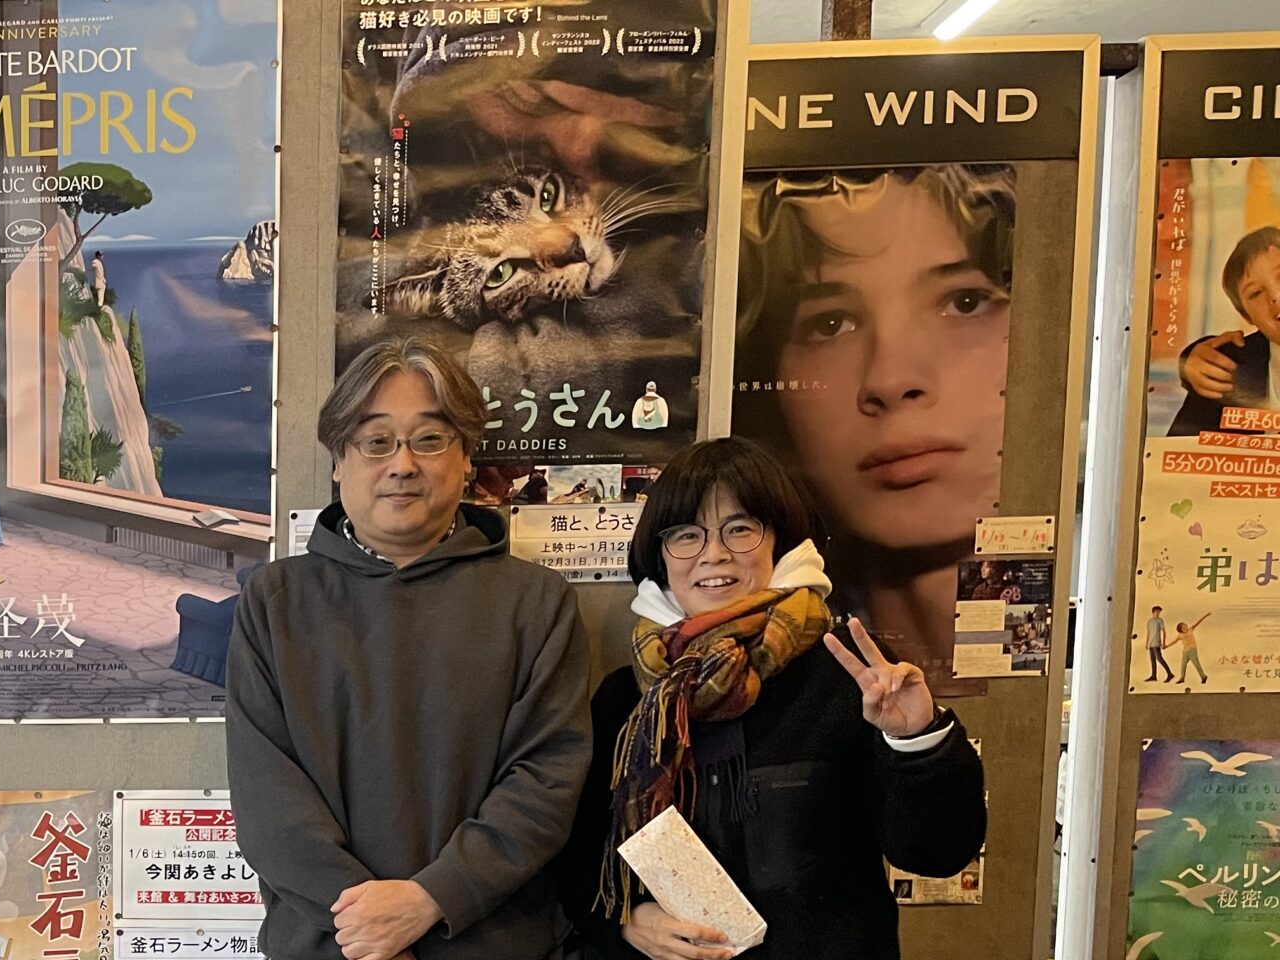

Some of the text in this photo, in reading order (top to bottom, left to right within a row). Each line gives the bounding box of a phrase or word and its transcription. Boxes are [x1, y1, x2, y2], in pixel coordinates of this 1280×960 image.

[28, 47, 137, 76] BARDOT
[865, 88, 1038, 127] WIND
[2, 164, 48, 174] A FILM BY
[32, 175, 104, 192] GODARD
[22, 196, 50, 204] ALBERTO
[496, 438, 568, 451] DADDIES
[1196, 547, 1280, 593] 弟は
[17, 648, 74, 660] 4Kレストア版
[186, 829, 236, 842] 公開記念
[145, 863, 256, 882] 今関あきよし
